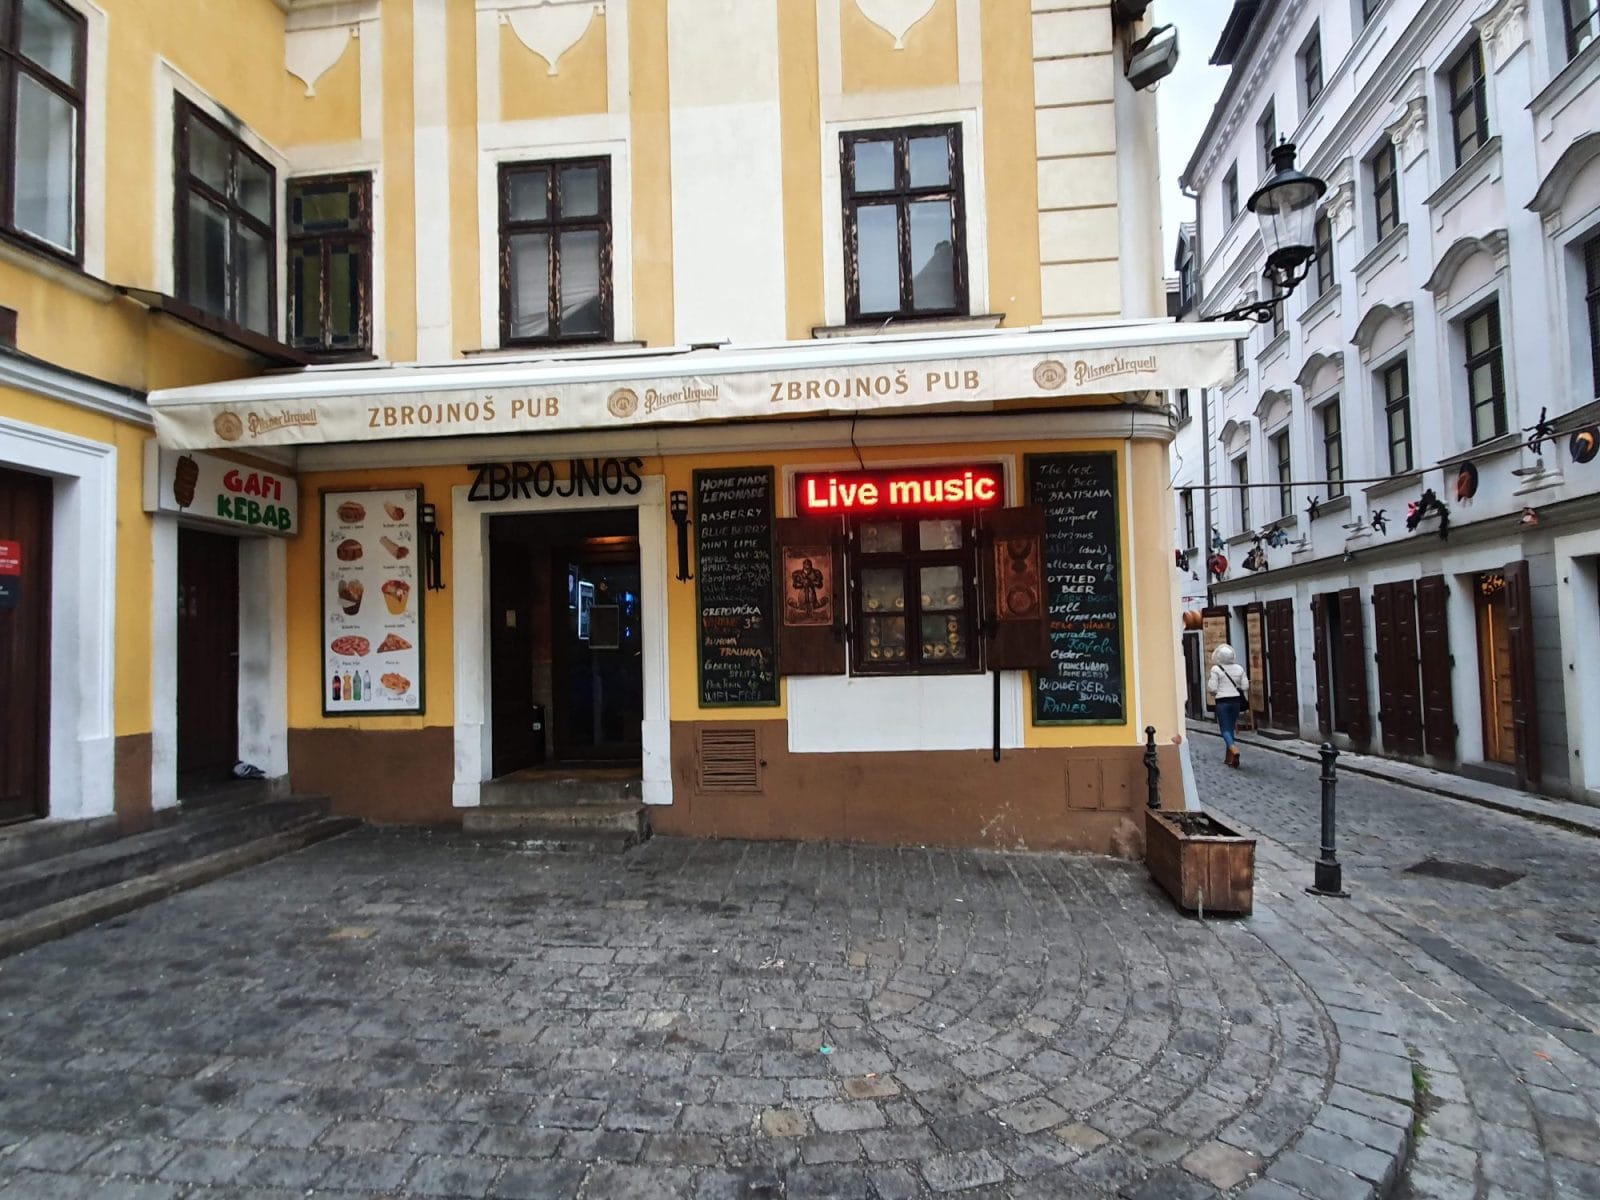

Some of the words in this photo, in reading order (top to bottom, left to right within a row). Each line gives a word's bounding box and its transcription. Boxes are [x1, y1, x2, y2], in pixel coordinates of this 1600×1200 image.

[1074, 359, 1116, 386] Pilsner
[1114, 355, 1157, 375] Urquell
[770, 368, 909, 402] ZBROJNOŠ
[926, 370, 980, 393] PUB
[643, 388, 684, 415] Pilsner
[682, 385, 719, 408] Urquell
[368, 395, 496, 428] ZBROJNOŠ
[511, 396, 559, 420] PUB
[223, 469, 281, 501] GAFI
[807, 478, 879, 508] Live
[889, 471, 996, 504] music
[702, 487, 766, 504] LEMONADE
[1048, 489, 1112, 503] BRATISLAVA
[217, 494, 291, 530] KEBAB
[701, 508, 762, 523] RASBERRY
[701, 540, 728, 551] MINT
[734, 539, 758, 549] LIME
[1047, 574, 1097, 585] OTTLED
[1061, 585, 1096, 595] BEER
[1038, 677, 1105, 695] BUDWEISER
[1043, 696, 1092, 714] RADLER
